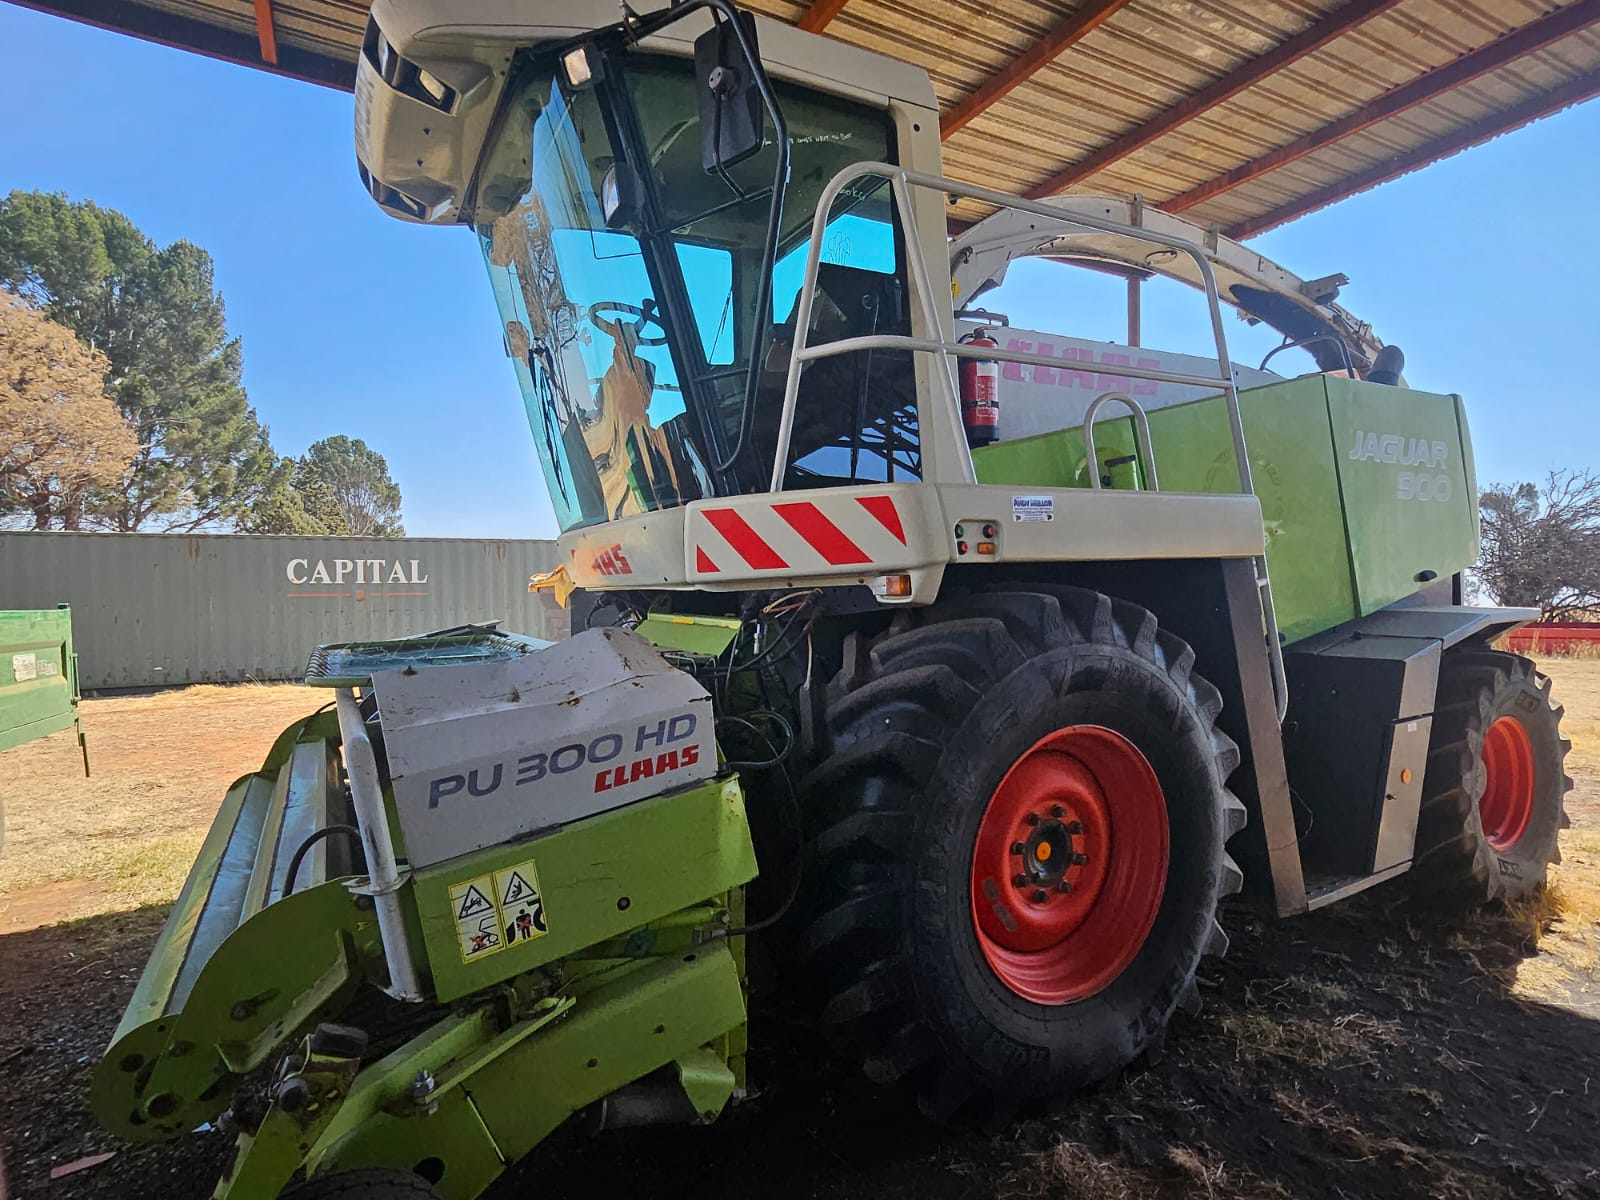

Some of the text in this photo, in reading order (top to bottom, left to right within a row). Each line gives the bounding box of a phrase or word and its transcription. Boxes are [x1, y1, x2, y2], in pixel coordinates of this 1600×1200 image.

[1002, 337, 1160, 396] CLAAS
[1349, 430, 1448, 469] JAGUAR
[1397, 471, 1452, 502] 900
[286, 558, 429, 585] CAPITAL
[428, 713, 697, 809] PU 300 HD
[593, 744, 699, 794] CLAAS
